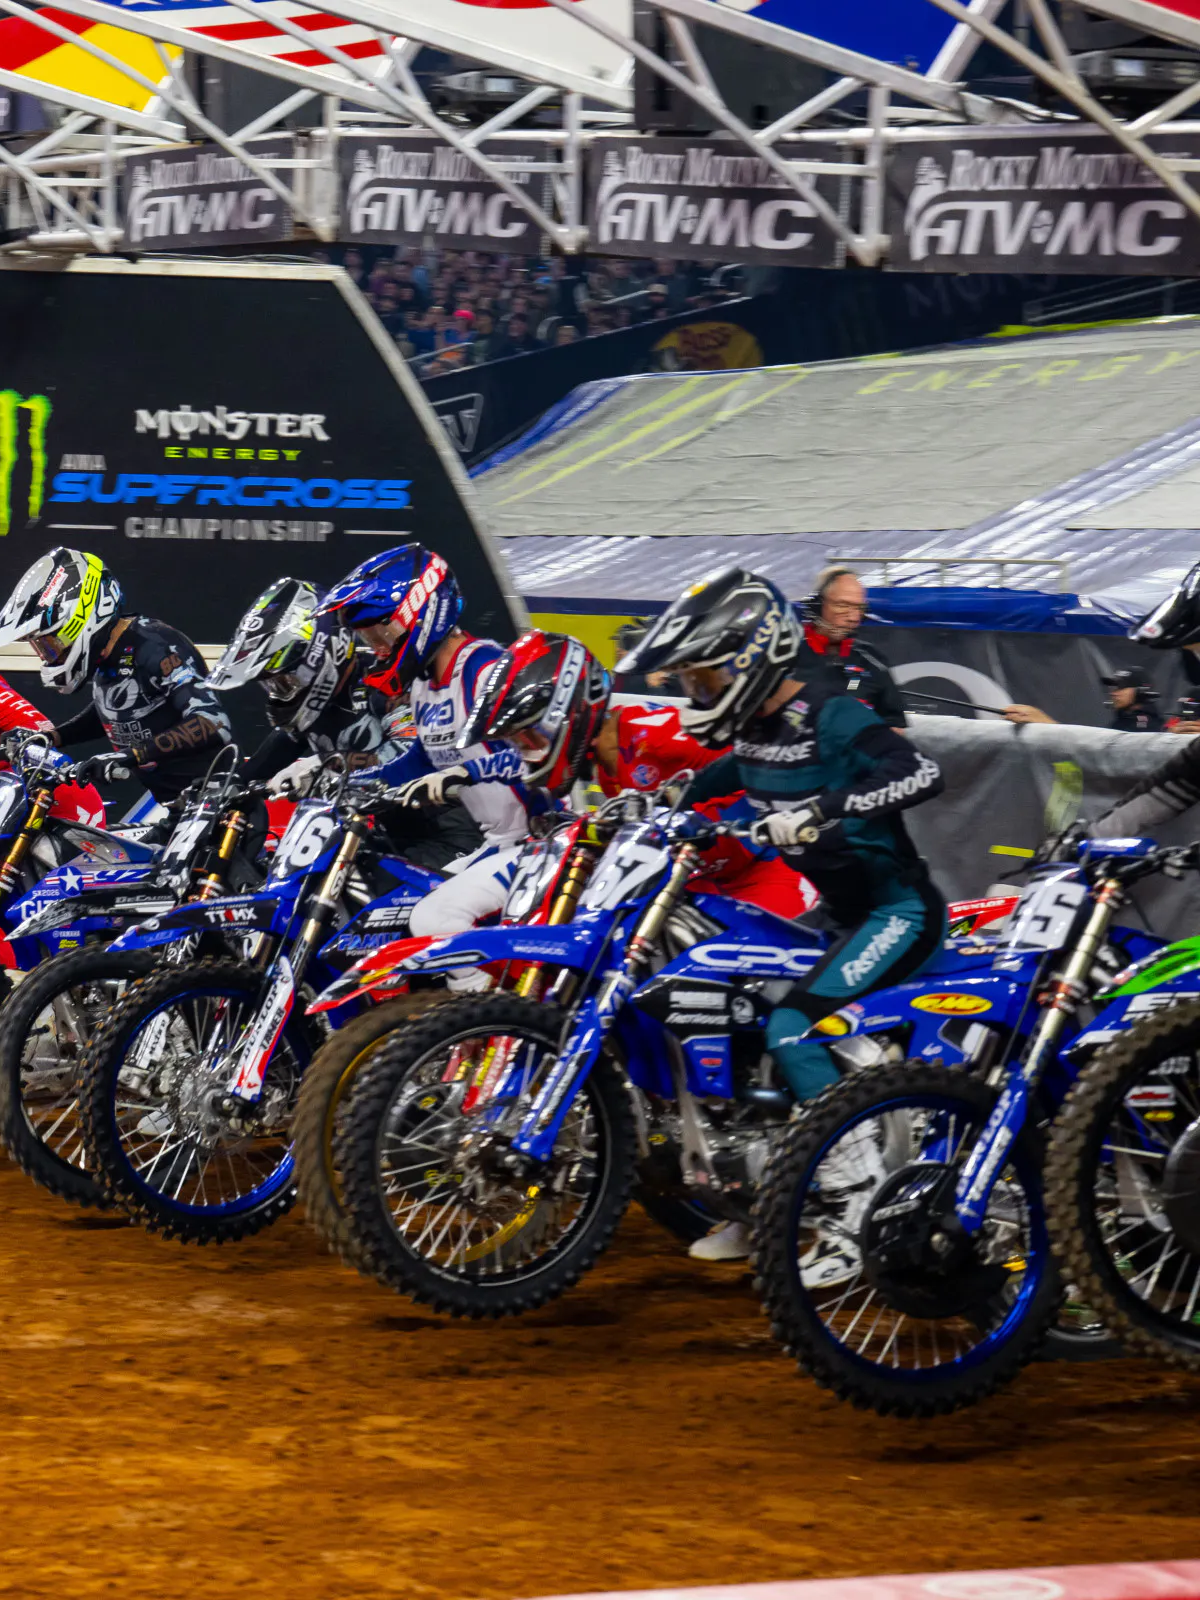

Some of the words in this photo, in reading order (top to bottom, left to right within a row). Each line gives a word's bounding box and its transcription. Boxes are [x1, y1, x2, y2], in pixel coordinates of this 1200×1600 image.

[947, 149, 1036, 191] ROCKY
[1031, 146, 1191, 188] MOUNTA
[135, 404, 332, 441] MONSTER
[59, 453, 108, 471] AMA
[164, 446, 302, 461] ENERGY
[48, 472, 414, 510] SUPERCROSS
[123, 515, 335, 543] CHAMPIONSHIP
[398, 557, 447, 626] 100%
[243, 983, 279, 1059] DUNLOP
